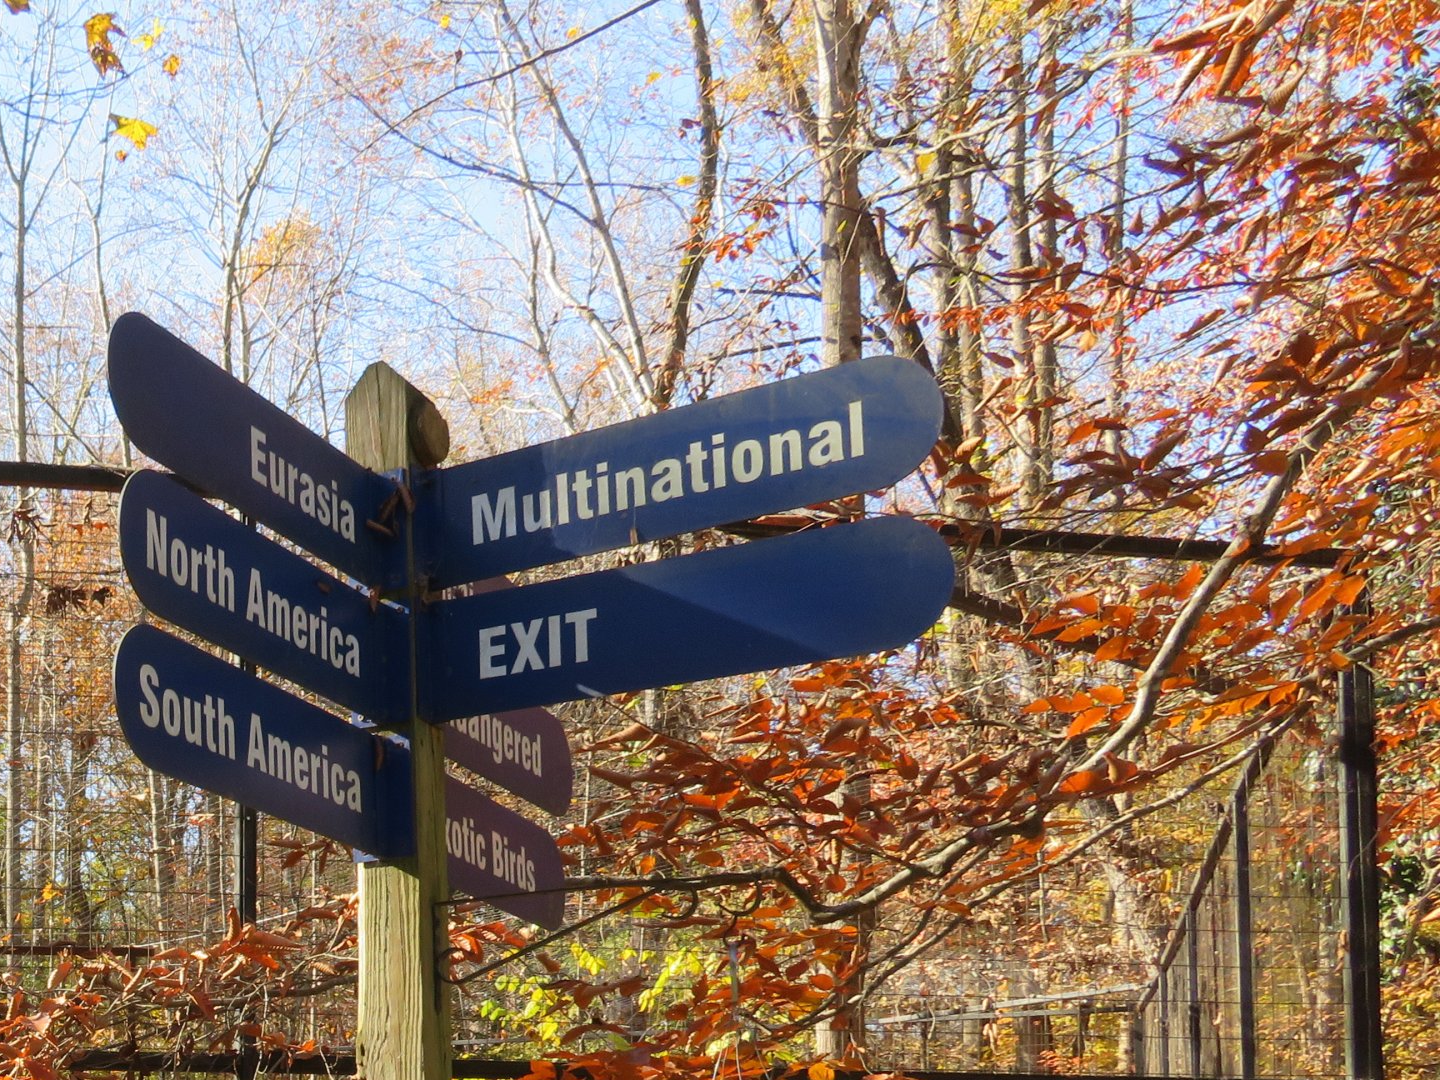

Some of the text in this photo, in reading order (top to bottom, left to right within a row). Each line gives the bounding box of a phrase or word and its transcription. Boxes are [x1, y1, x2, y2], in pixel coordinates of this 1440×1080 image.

[250, 425, 356, 544] Eurasia
[471, 401, 865, 546] Multinational
[145, 509, 360, 678] North America
[478, 608, 597, 680] EXIT
[138, 664, 362, 814] South America
[445, 816, 536, 893] xotic Birds
